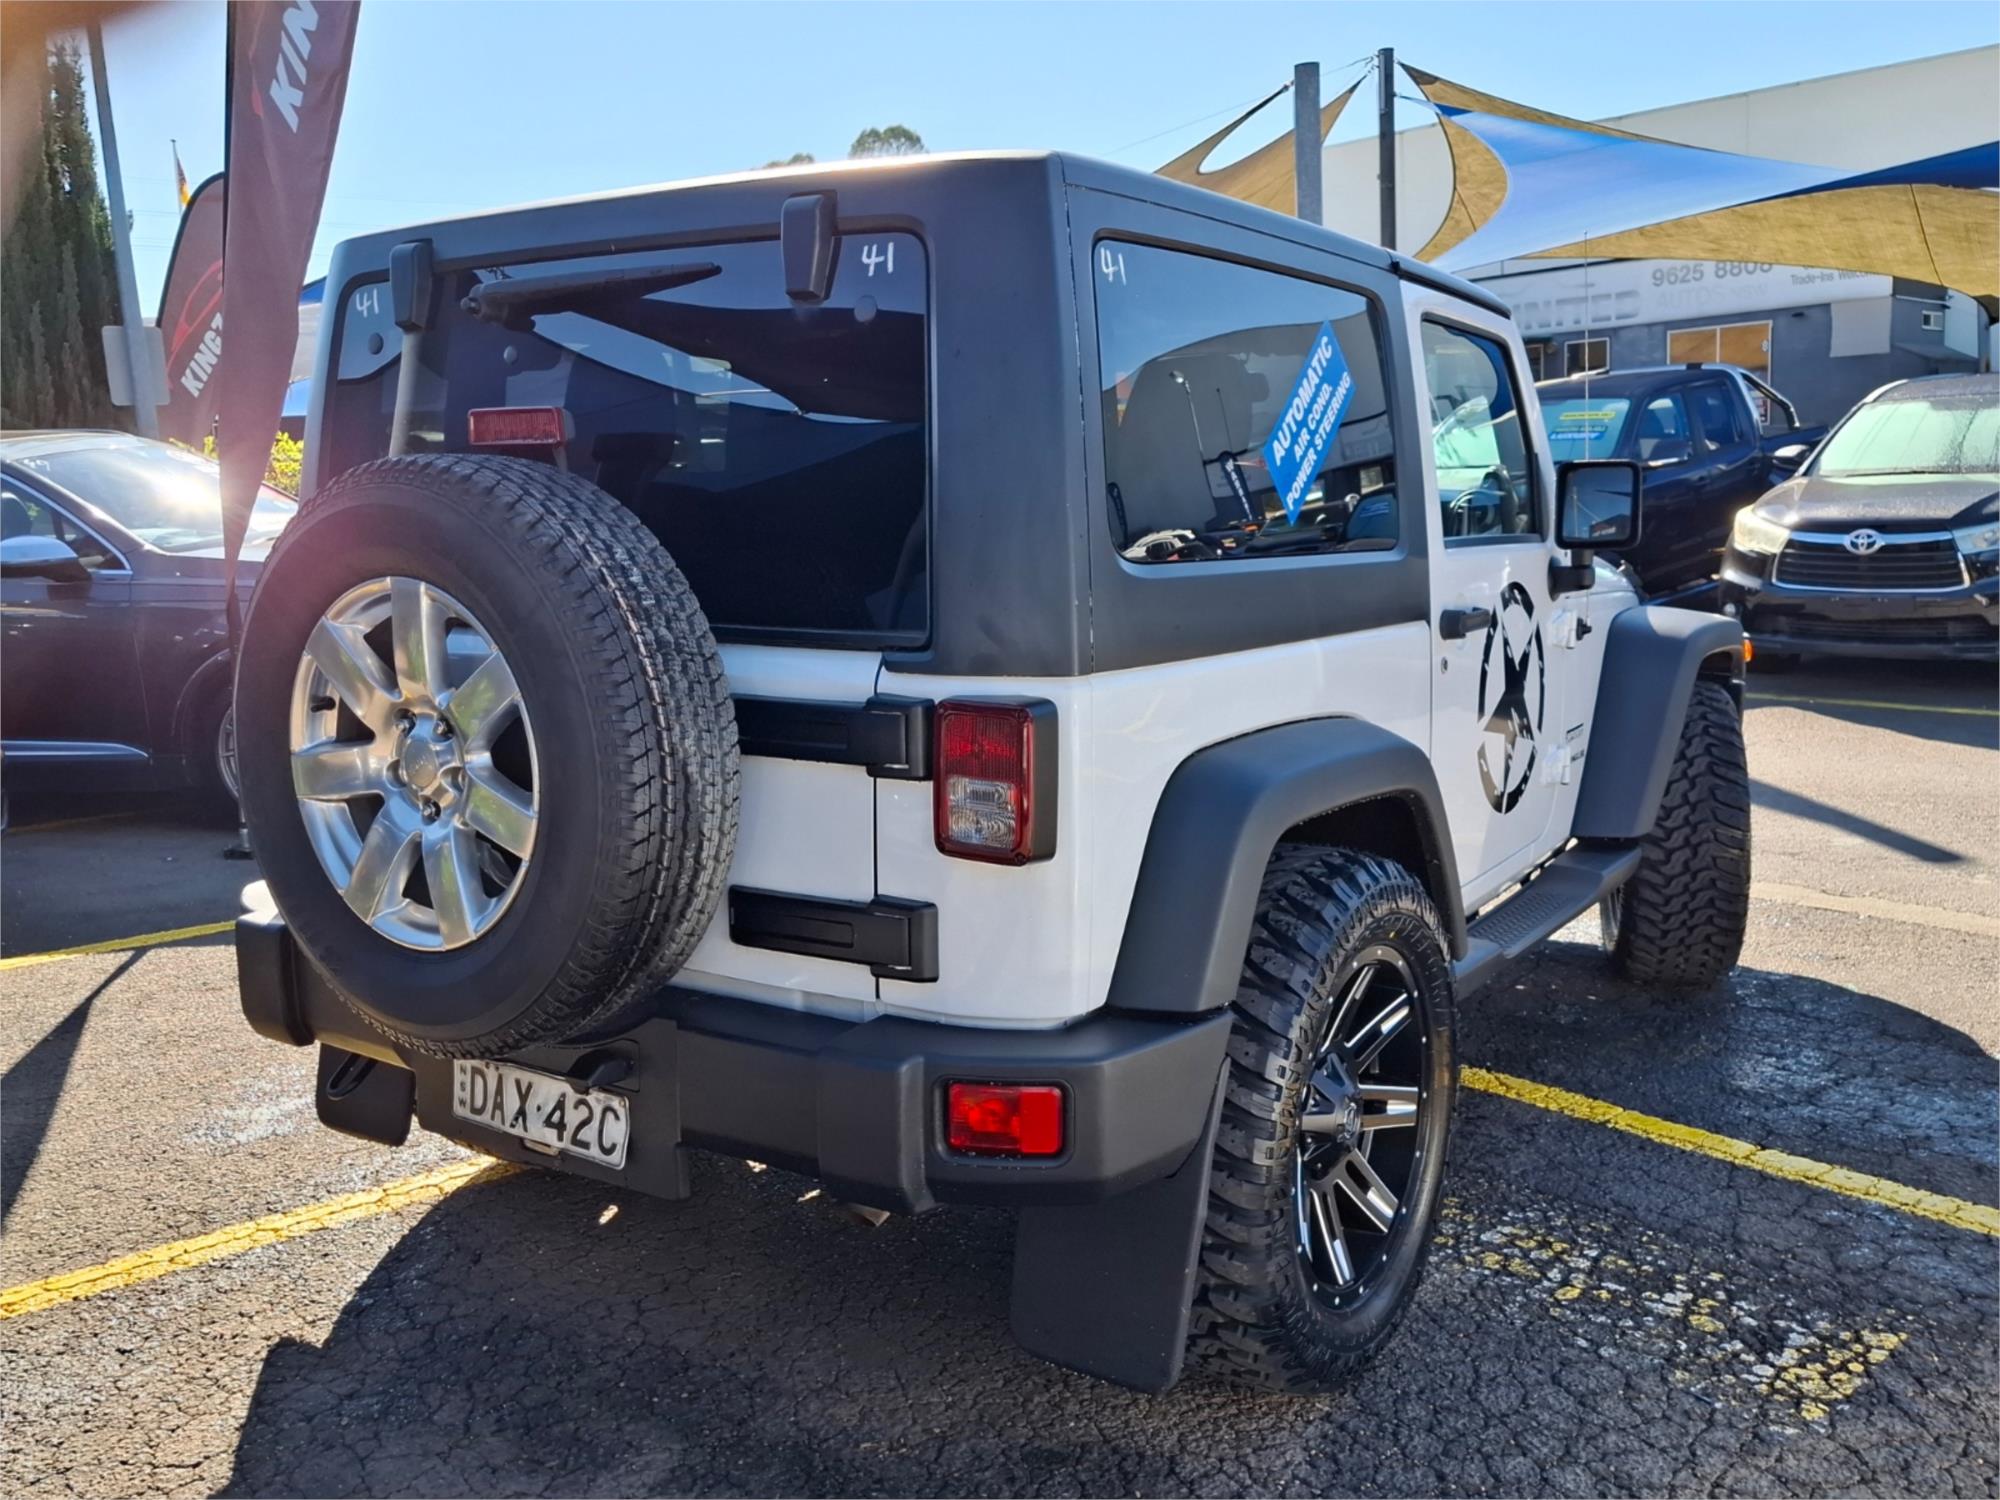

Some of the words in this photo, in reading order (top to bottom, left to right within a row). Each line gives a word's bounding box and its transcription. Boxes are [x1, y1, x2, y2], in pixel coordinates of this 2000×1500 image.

[861, 241, 895, 277] 41
[1100, 247, 1127, 286] 41
[1652, 263, 1705, 287] 9625
[356, 288, 379, 318] 41
[1272, 336, 1333, 466] AUTOMATIC
[1286, 447, 1317, 511] POWER
[1314, 371, 1351, 451] STEERING
[1294, 427, 1311, 463] AIR
[1307, 383, 1333, 430] COND.
